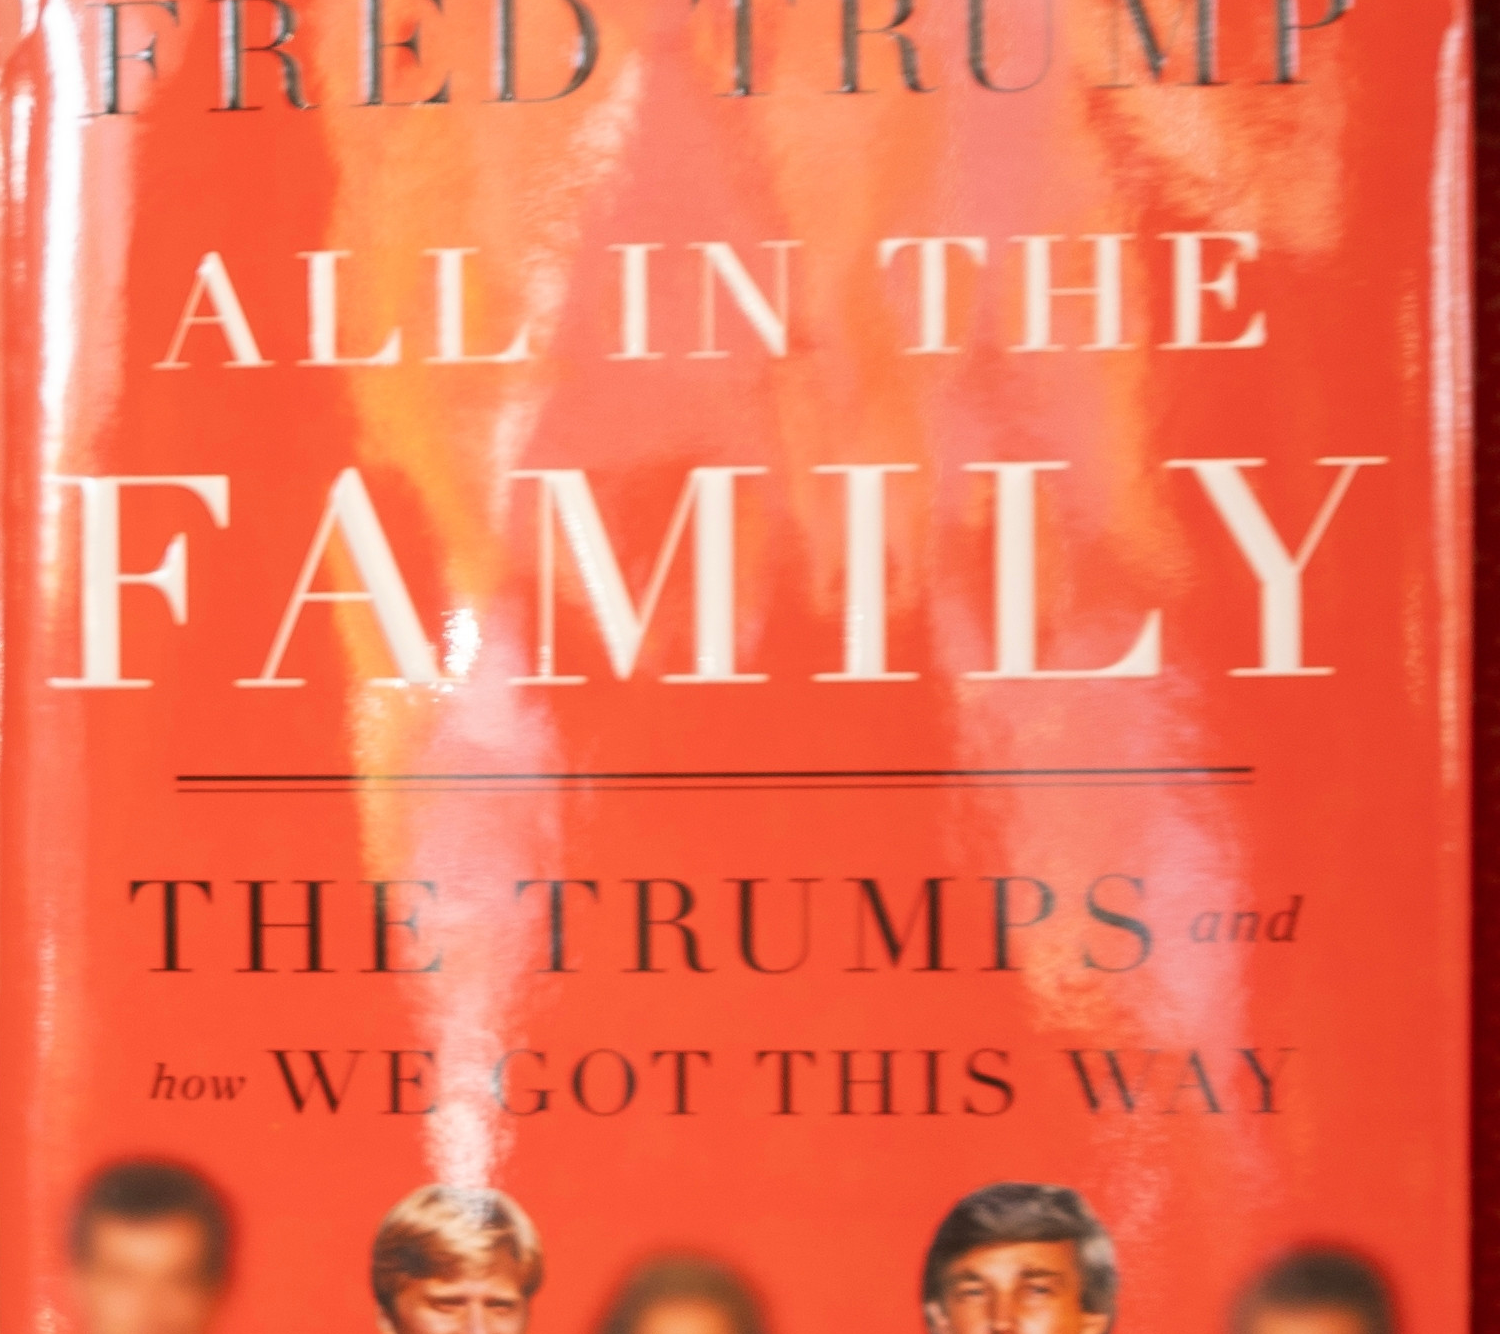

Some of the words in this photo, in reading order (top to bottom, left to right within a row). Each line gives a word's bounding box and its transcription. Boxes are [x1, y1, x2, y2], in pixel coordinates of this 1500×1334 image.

[152, 246, 534, 371] ALL
[607, 239, 803, 361] IN
[878, 229, 1269, 357] THE
[46, 454, 1390, 691] FAMILY
[128, 876, 445, 977] THE
[514, 873, 1156, 977] TRUMPS
[1187, 893, 1305, 947] and
[148, 1062, 246, 1104] how
[269, 1047, 442, 1118] WE
[488, 1047, 715, 1120] GOT
[756, 1047, 1017, 1117] THIS
[1067, 1045, 1302, 1120] WAY
